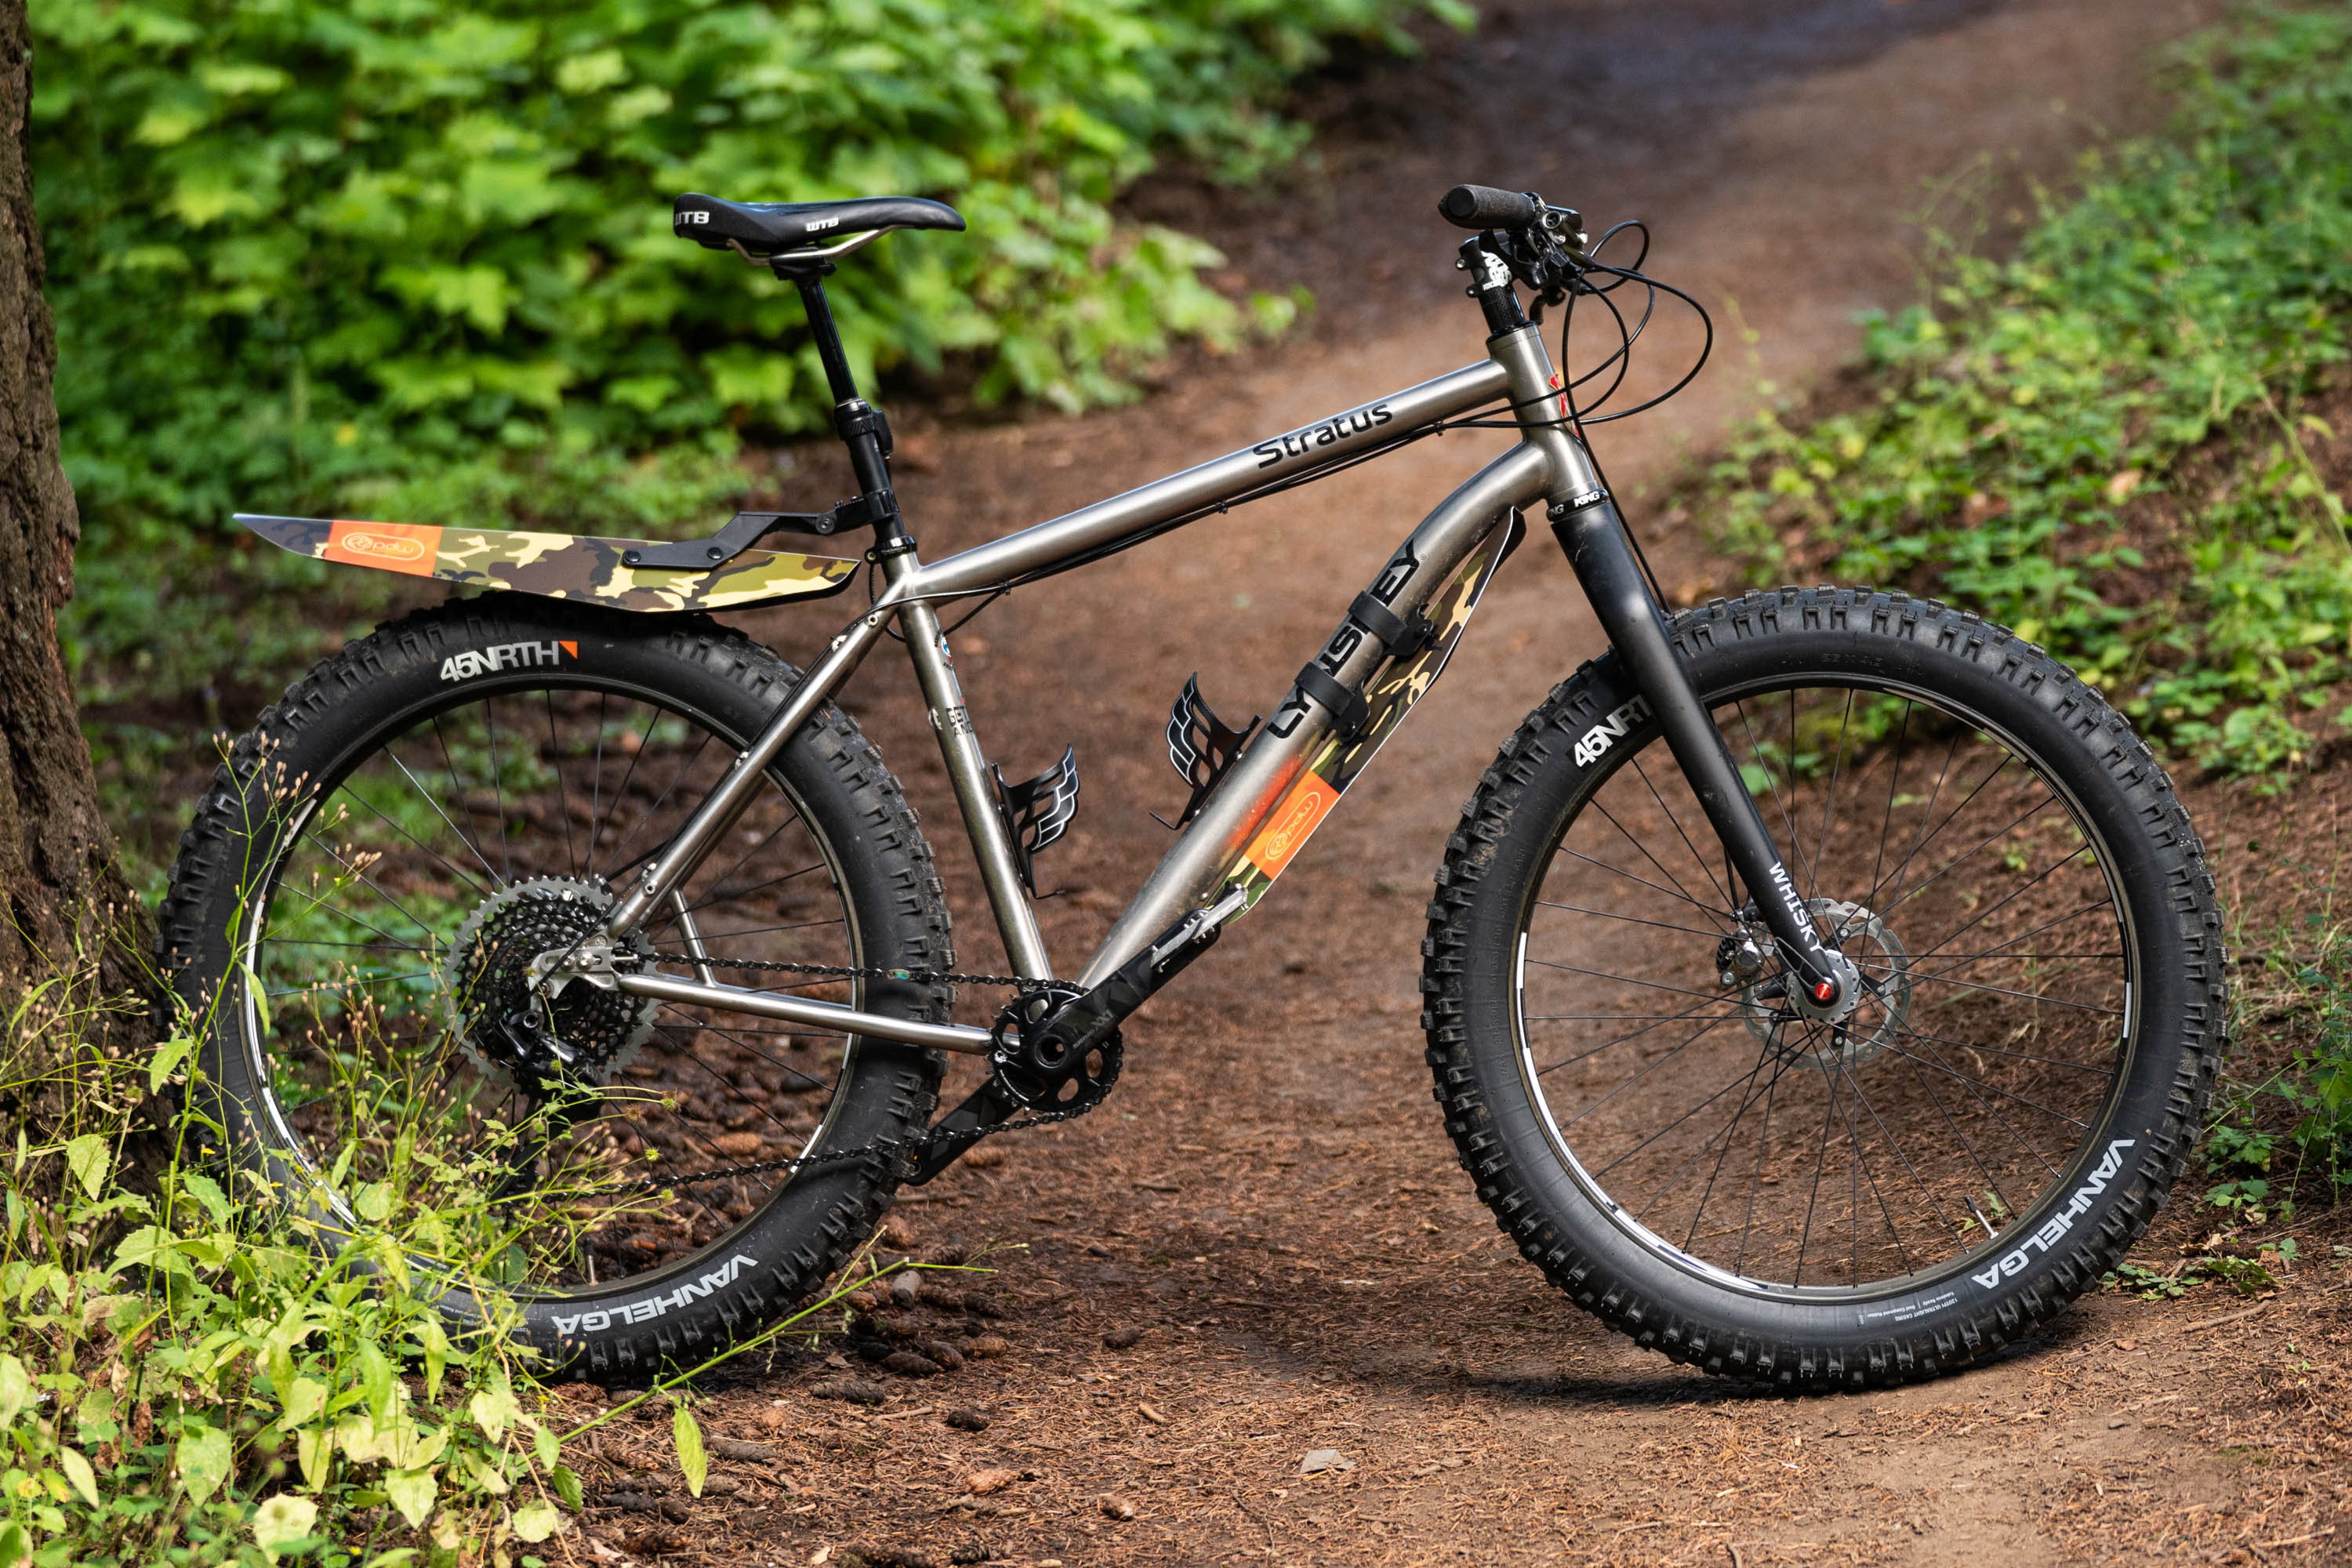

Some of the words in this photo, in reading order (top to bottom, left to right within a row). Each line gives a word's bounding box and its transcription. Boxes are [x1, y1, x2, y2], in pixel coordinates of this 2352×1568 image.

[806, 217, 840, 232] WTB
[1254, 403, 1392, 469] Stratus
[1574, 490, 1600, 507] KING
[440, 640, 561, 683] 45NRTH
[1769, 861, 1823, 952] WHISKY
[1970, 1138, 2136, 1290] VANHELGA
[551, 1254, 759, 1334] VANHELGA
